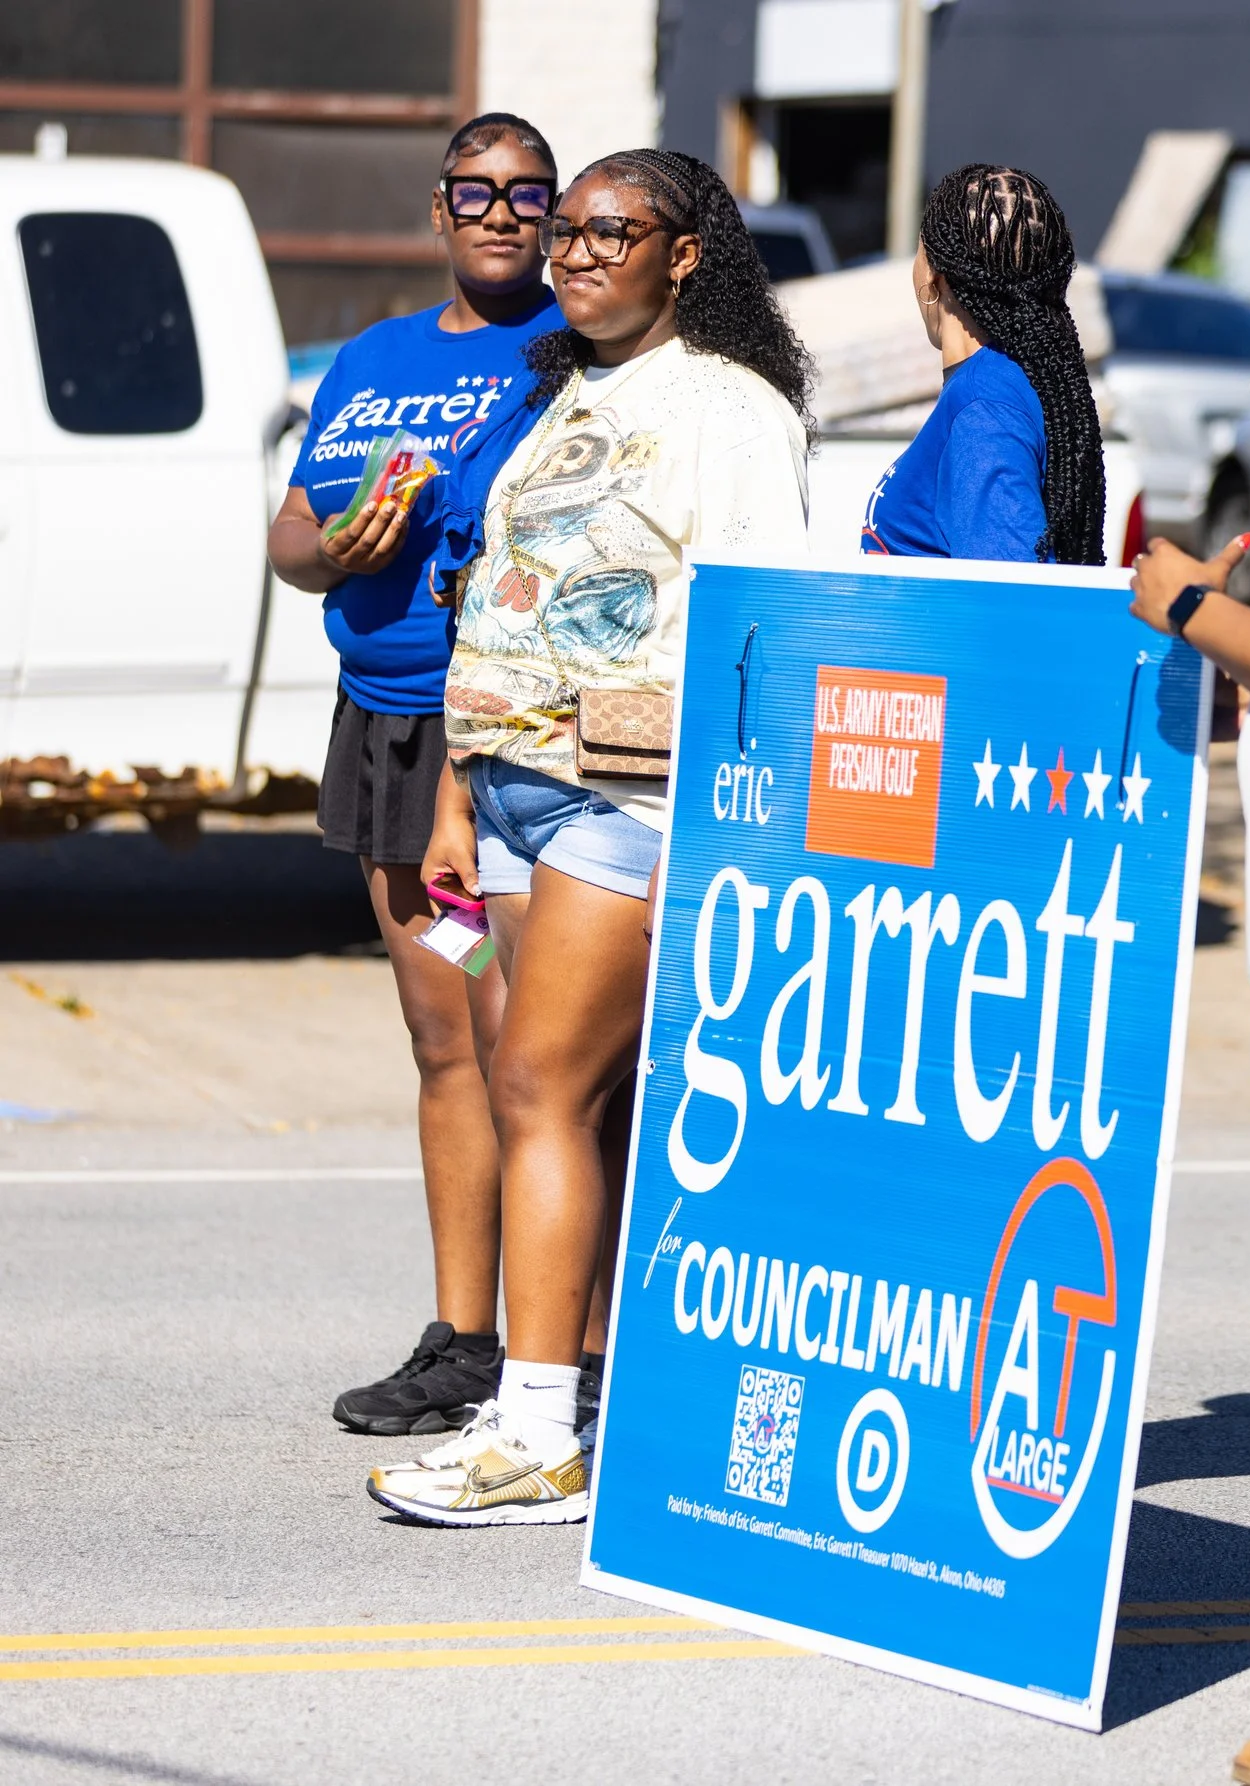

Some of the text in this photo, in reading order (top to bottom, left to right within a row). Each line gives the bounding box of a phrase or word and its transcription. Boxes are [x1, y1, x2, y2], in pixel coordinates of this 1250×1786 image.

[318, 386, 501, 444] garret
[817, 685, 943, 742] U.S. ARMY VETERAN
[713, 737, 774, 826] eric
[829, 741, 920, 796] PERSIAN GULF
[667, 837, 1136, 1193] garrett
[643, 1196, 973, 1392] for COUNCILMAN
[984, 1279, 1117, 1438] AT
[856, 1429, 890, 1493] D
[987, 1425, 1071, 1497] LARGE
[667, 1494, 682, 1513] Paid
[681, 1495, 693, 1517] for
[692, 1501, 704, 1522] by:
[703, 1503, 728, 1526] Friends
[728, 1510, 738, 1526] of
[736, 1511, 749, 1532] Eric
[750, 1515, 774, 1538] Garrett
[774, 1522, 813, 1550] Committee,
[813, 1532, 828, 1552] Eric
[827, 1535, 852, 1559] Garrett
[857, 1542, 891, 1568] Treasurer
[890, 1551, 909, 1573] 1070
[908, 1556, 930, 1578] Hazel
[939, 1564, 963, 1590] Akron,
[963, 1570, 983, 1593] Ohio
[982, 1576, 1007, 1599] 44305
